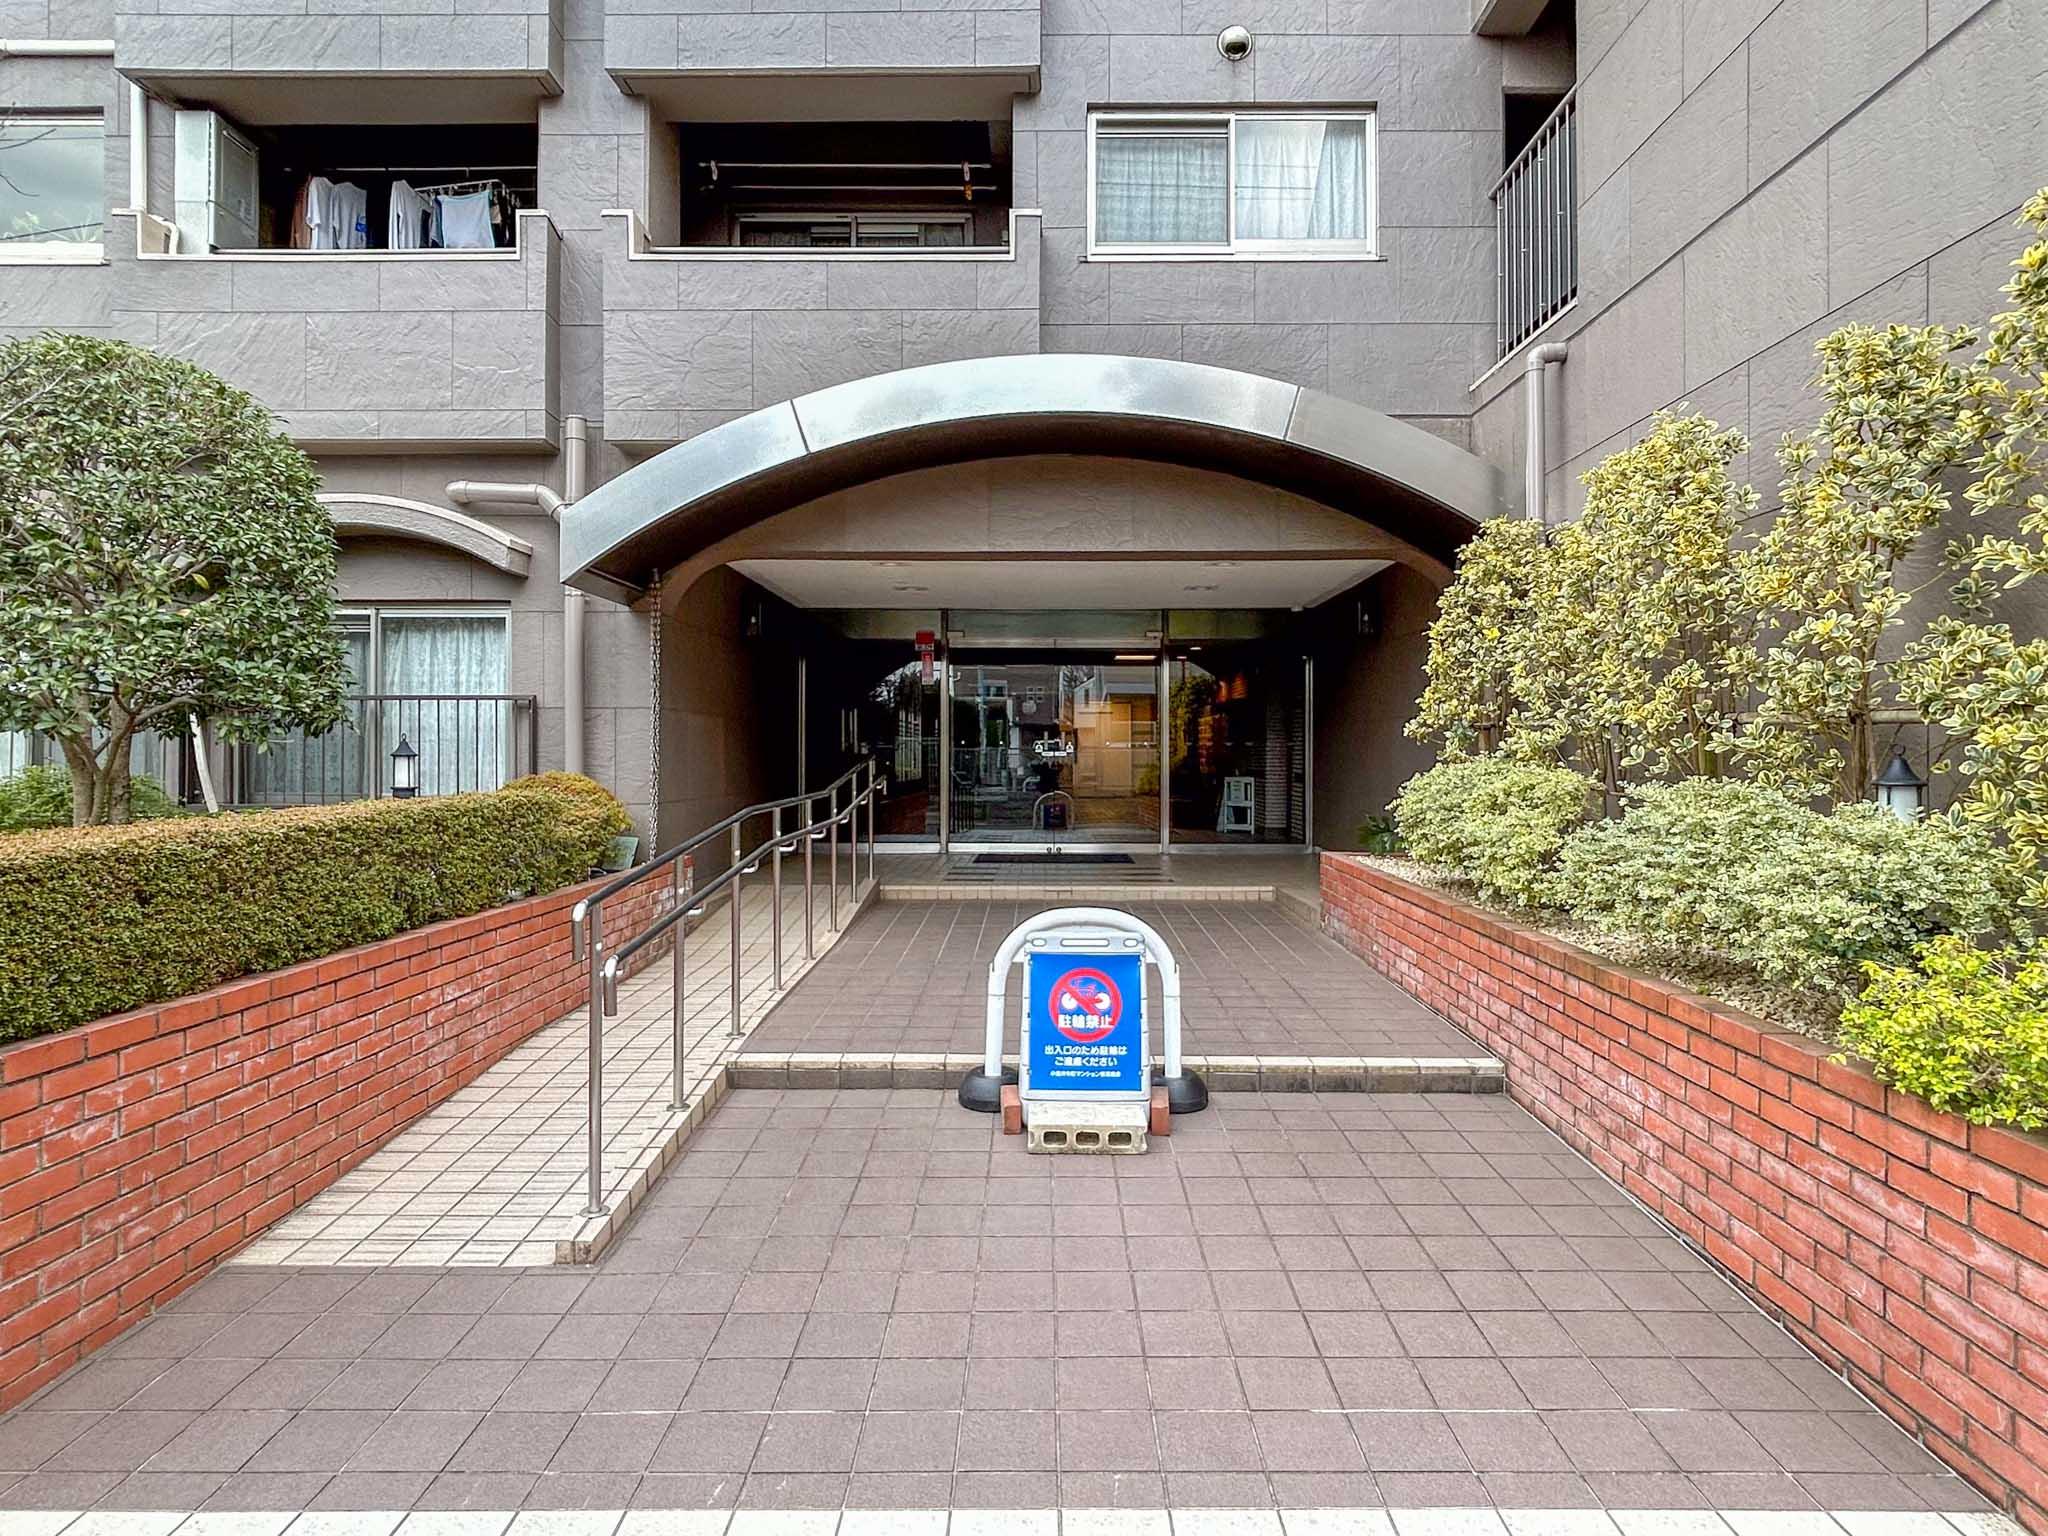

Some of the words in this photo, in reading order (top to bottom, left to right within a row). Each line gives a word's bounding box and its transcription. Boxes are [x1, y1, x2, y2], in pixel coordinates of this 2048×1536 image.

[1058, 1014, 1115, 1029] 駐輪禁止
[1044, 1045, 1128, 1055] 出入口のため駐輪は
